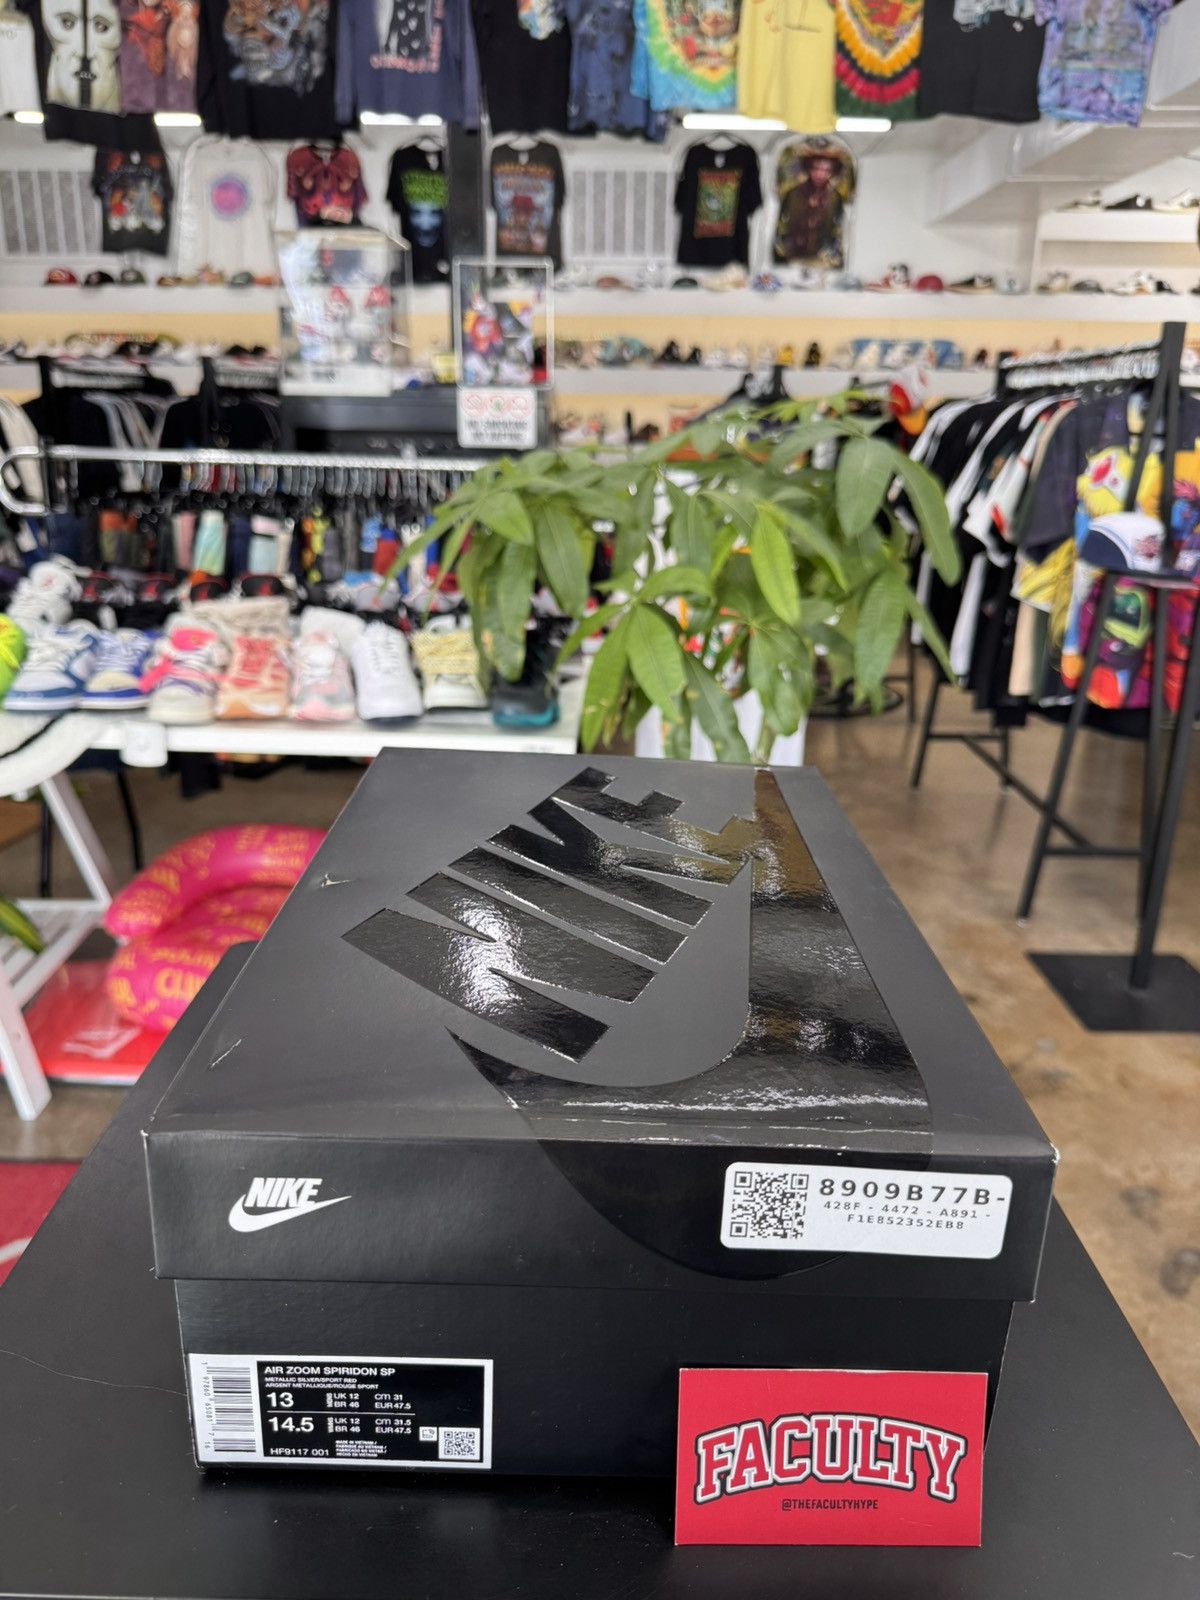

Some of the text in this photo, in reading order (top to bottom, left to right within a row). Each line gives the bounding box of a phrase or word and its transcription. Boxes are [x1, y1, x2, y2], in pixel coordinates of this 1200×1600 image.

[342, 766, 752, 1063] NIKE
[244, 1177, 323, 1208] NIKE
[819, 1178, 1006, 1206] 8909B77B-
[264, 1366, 396, 1376] AIR ZOOM SPIRIDON SP
[266, 1392, 294, 1408] 13
[393, 1402, 412, 1410] 47.5
[268, 1416, 315, 1433] 14.5
[334, 1417, 348, 1425] UK
[334, 1425, 348, 1433] BR
[374, 1426, 393, 1434] EUR
[269, 1447, 309, 1456] HF9117
[694, 1411, 968, 1505] FACULTY
[781, 1498, 879, 1512] @THEFACULTYHYPE
